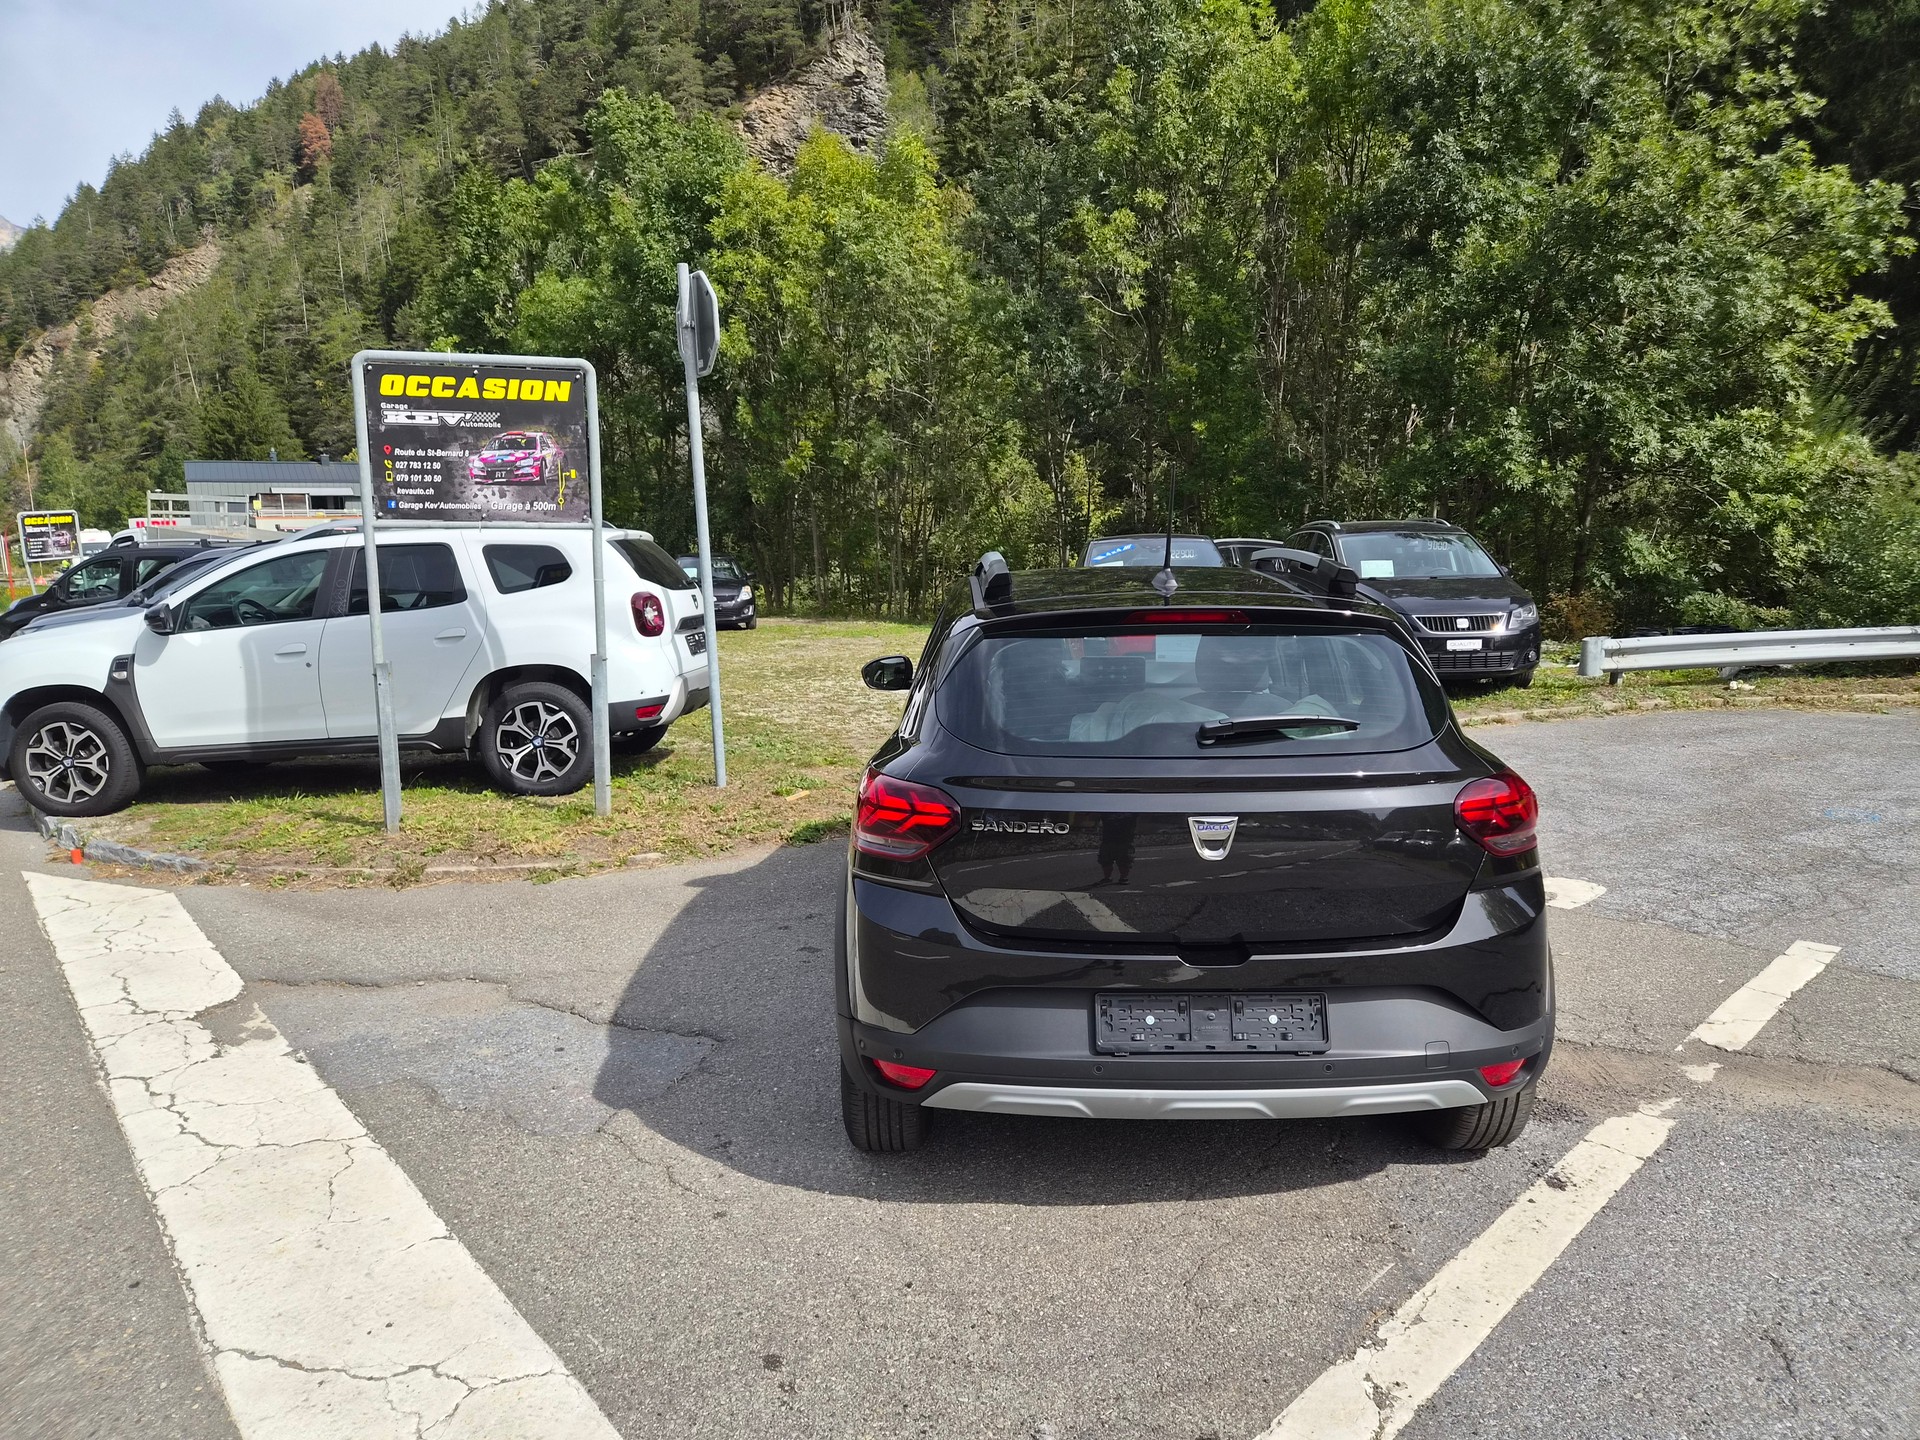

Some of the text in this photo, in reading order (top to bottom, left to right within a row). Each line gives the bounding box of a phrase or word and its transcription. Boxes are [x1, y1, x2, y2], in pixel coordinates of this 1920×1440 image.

[379, 374, 571, 402] OCCASION
[380, 402, 409, 410] Garage
[394, 448, 415, 456] Route
[416, 449, 426, 457] du
[427, 449, 463, 457] St-Bernard
[395, 461, 408, 469] 027
[396, 474, 409, 482] 079
[396, 487, 434, 495] kevauto.ch
[398, 501, 424, 510] Garage
[491, 502, 557, 511] Garage à 500m
[24, 516, 72, 525] OCCASION
[971, 819, 1070, 834] SANDERO
